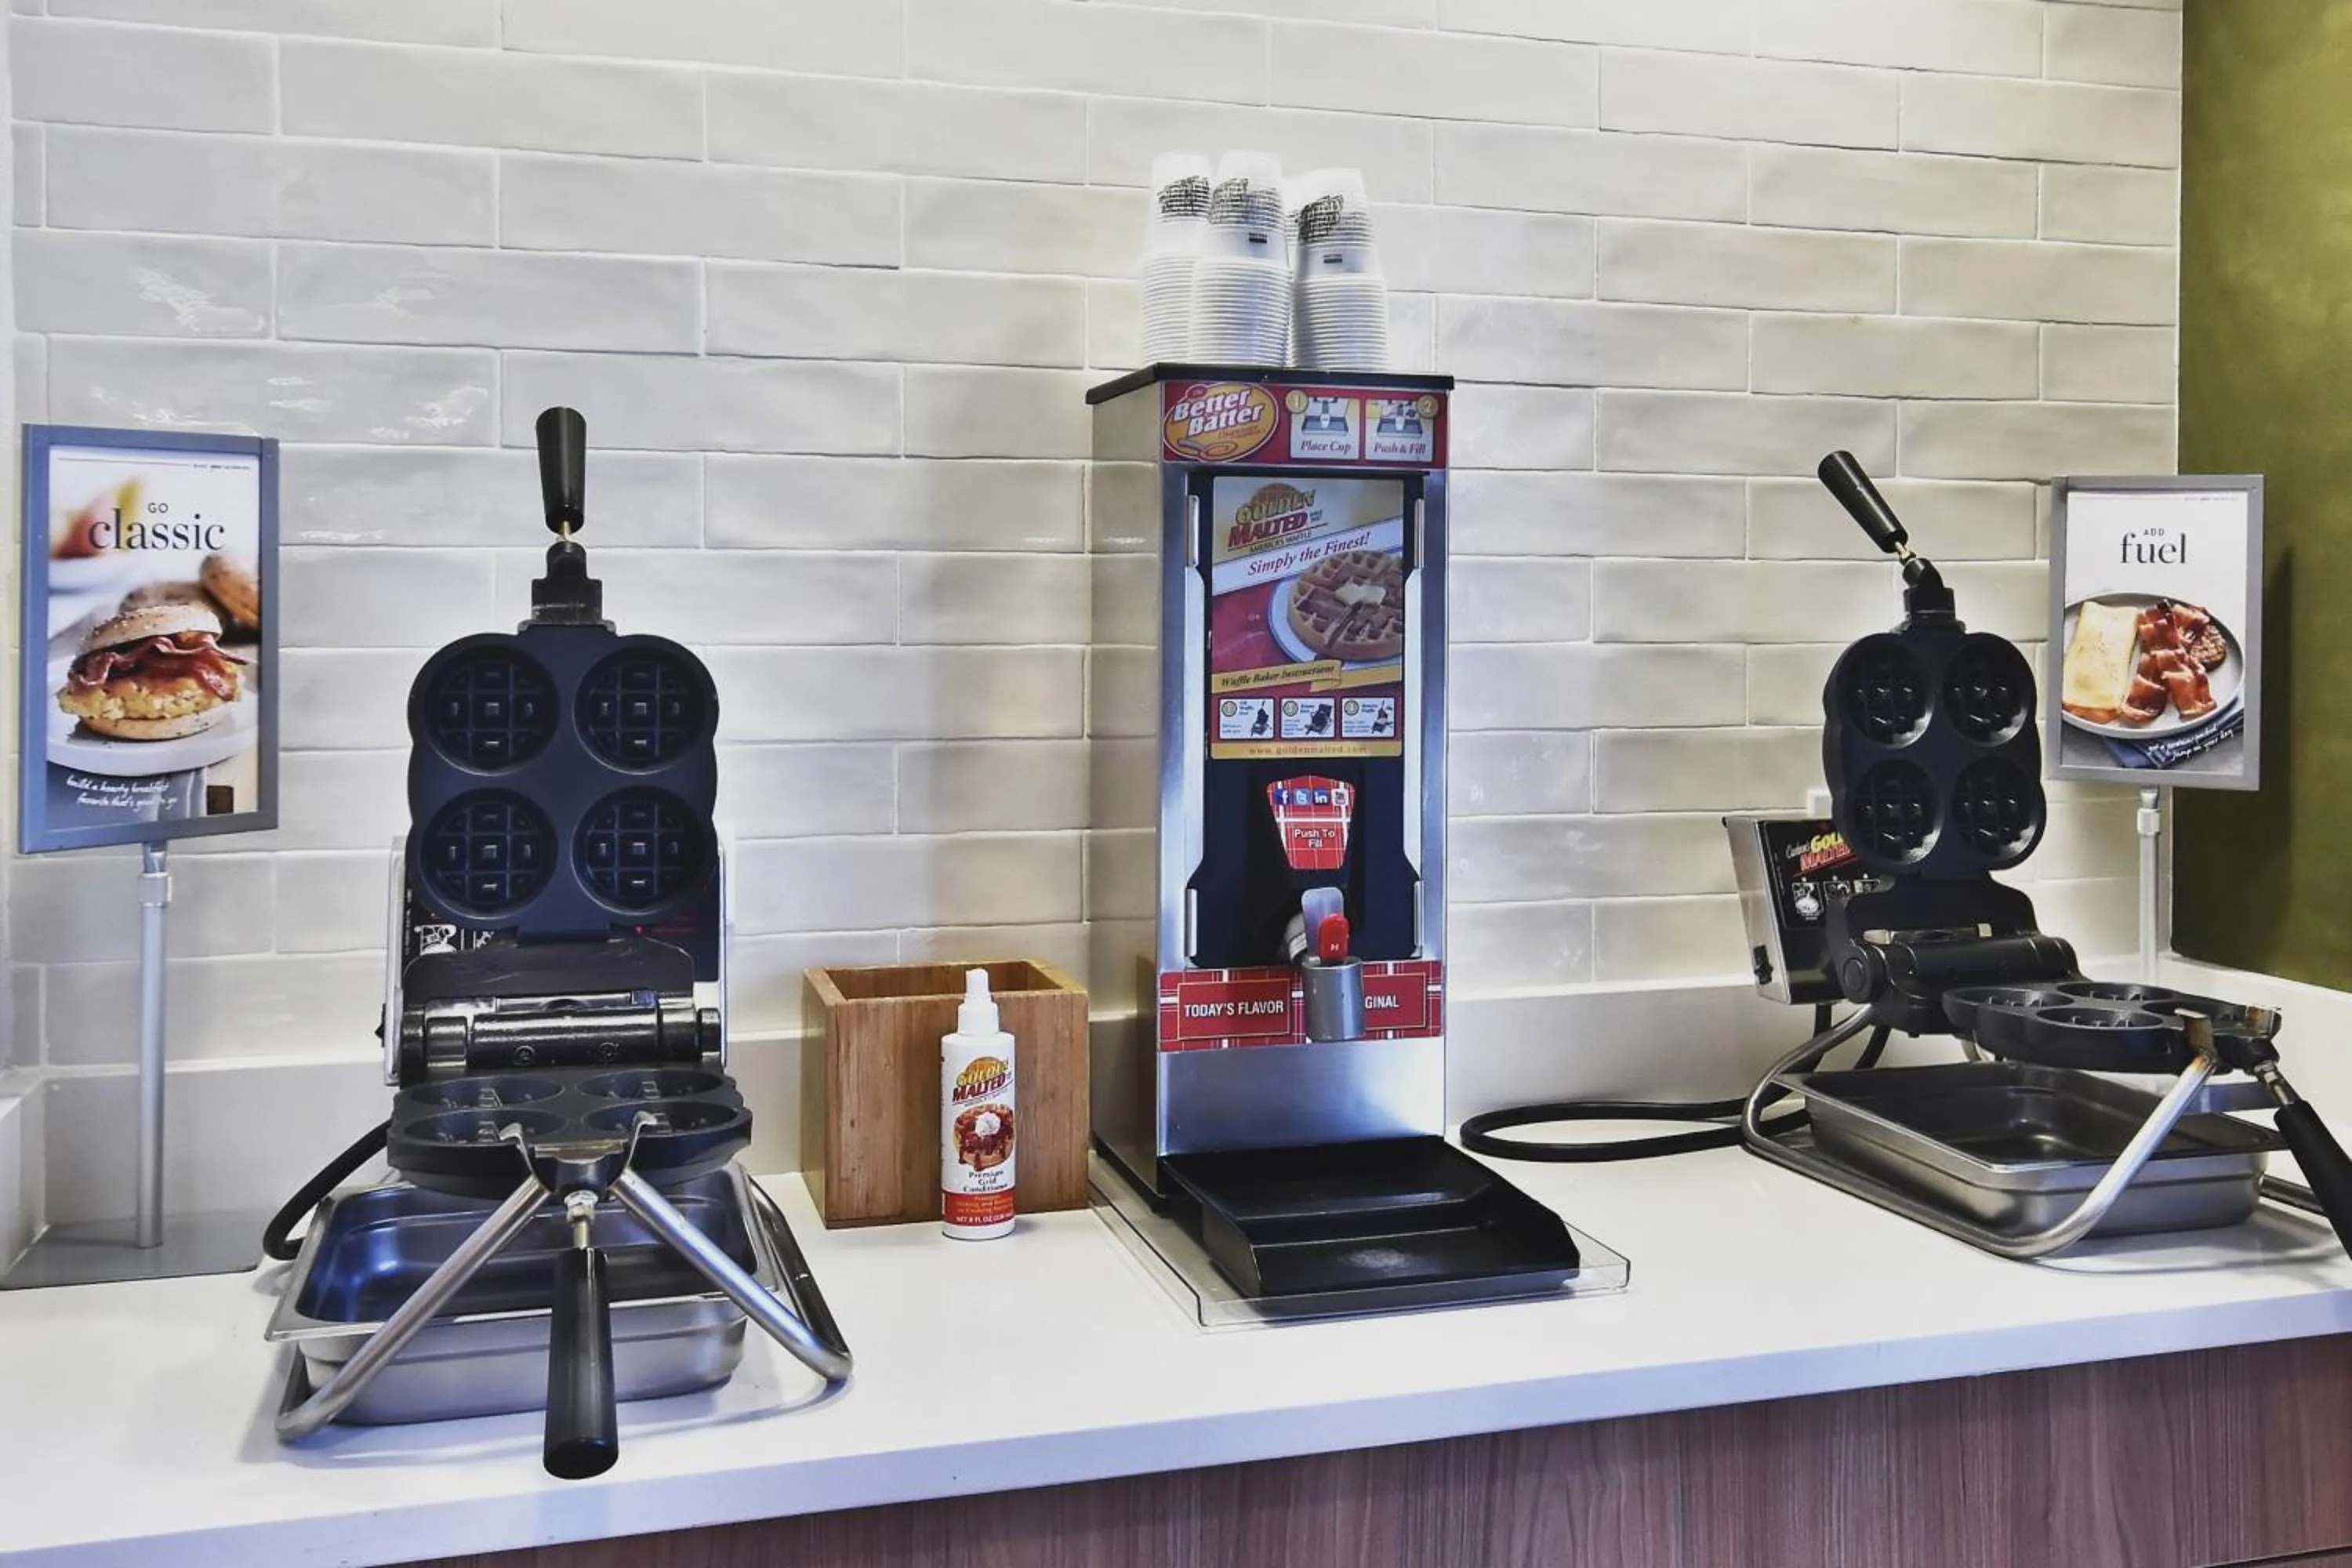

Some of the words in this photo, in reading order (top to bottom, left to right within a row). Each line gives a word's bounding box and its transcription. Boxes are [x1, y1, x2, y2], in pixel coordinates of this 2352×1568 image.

[1174, 390, 1251, 421] Better
[1425, 401, 1432, 412] 2
[1188, 404, 1264, 437] Batter
[1301, 439, 1328, 452] Place
[1330, 441, 1352, 455] Cup
[1374, 442, 1398, 452] Push
[1409, 443, 1427, 454] Fill
[147, 502, 169, 514] GO
[1236, 489, 1316, 524] GOLDEN
[88, 506, 226, 551] classic
[1229, 512, 1308, 548] MALTED
[2143, 528, 2165, 536] ADD
[1247, 552, 1297, 576] Simply
[1299, 546, 1323, 562] the
[1324, 531, 1371, 555] Finest!
[2120, 532, 2187, 564] fuel
[1221, 674, 1250, 687] Waffle
[1253, 671, 1279, 683] Baker
[1282, 666, 1335, 678] Instructions
[1294, 829, 1319, 838] Push
[1321, 829, 1335, 838] To
[1308, 839, 1323, 848] Fill
[1811, 831, 1844, 854] GOL
[1184, 1003, 1235, 1018] TODAY'S
[1238, 1000, 1284, 1015] FLAVOR
[1365, 996, 1399, 1009] GINAL
[953, 1073, 1006, 1102] MALTED
